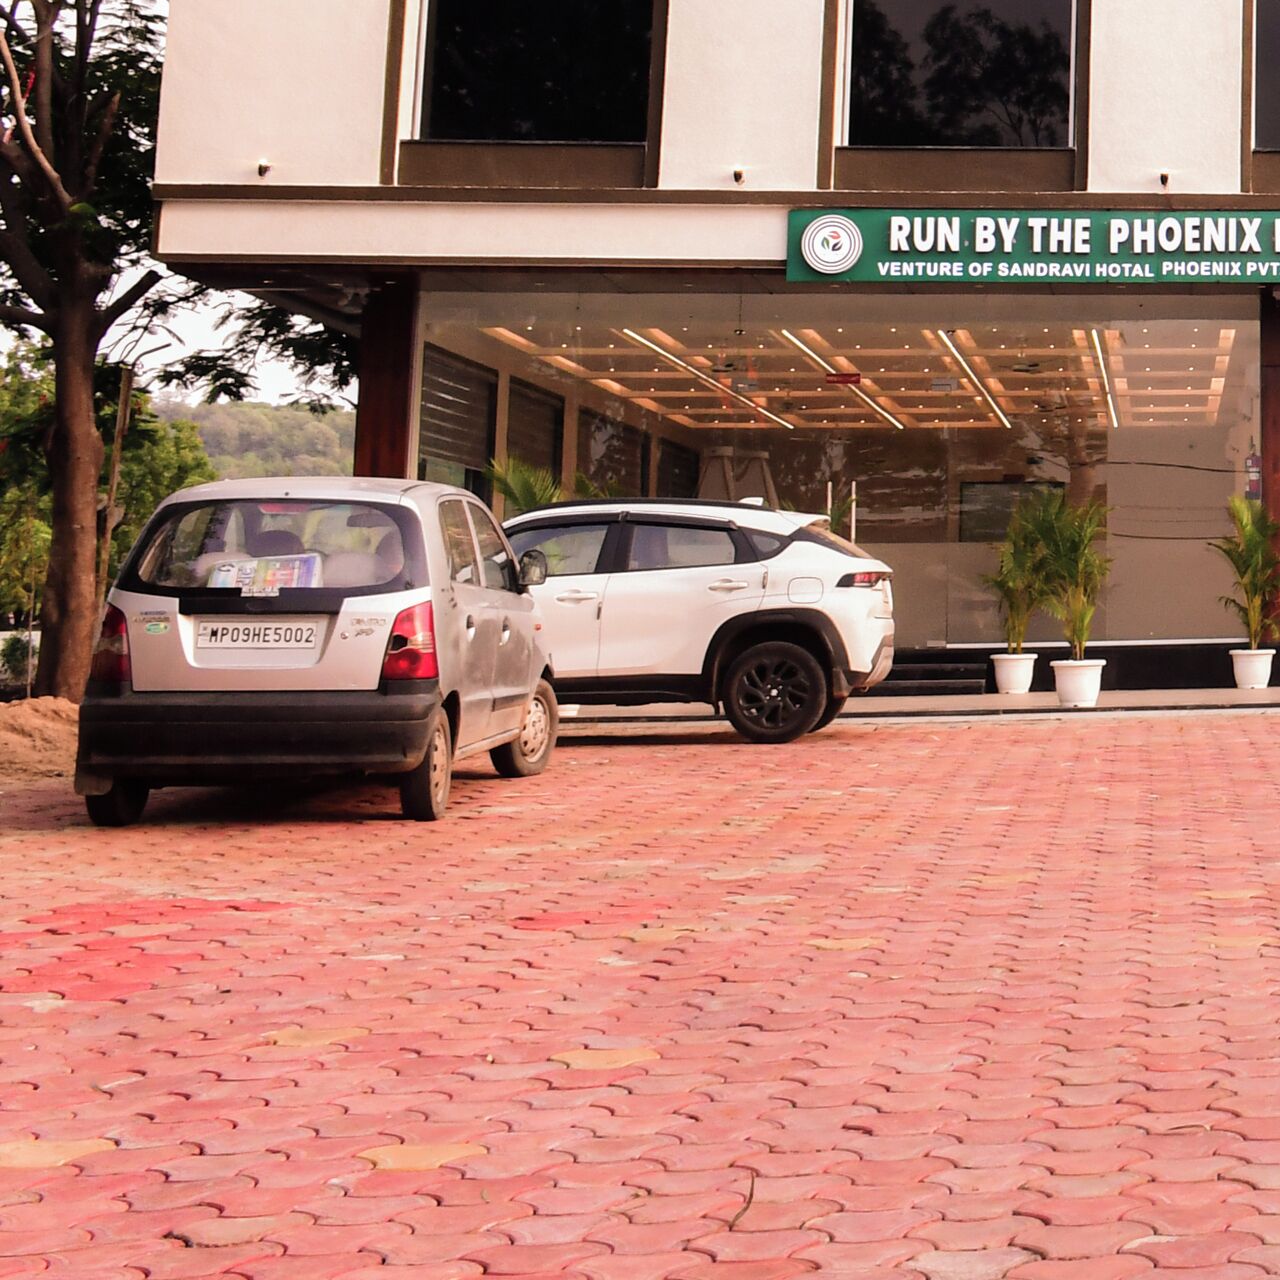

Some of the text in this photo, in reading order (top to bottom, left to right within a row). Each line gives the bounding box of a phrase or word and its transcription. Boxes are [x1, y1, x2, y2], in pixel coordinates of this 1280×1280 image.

[890, 216, 960, 252] RUN
[975, 217, 1020, 253] BY
[1027, 217, 1091, 253] THE
[1109, 217, 1262, 254] PHOENIX
[877, 261, 964, 277] VENTURE
[968, 262, 993, 277] OF
[997, 262, 1091, 277] SANDRAVI
[1095, 262, 1155, 278] HOTAL
[1161, 261, 1242, 277] PHOENIX
[209, 626, 314, 643] MP09HE5002
